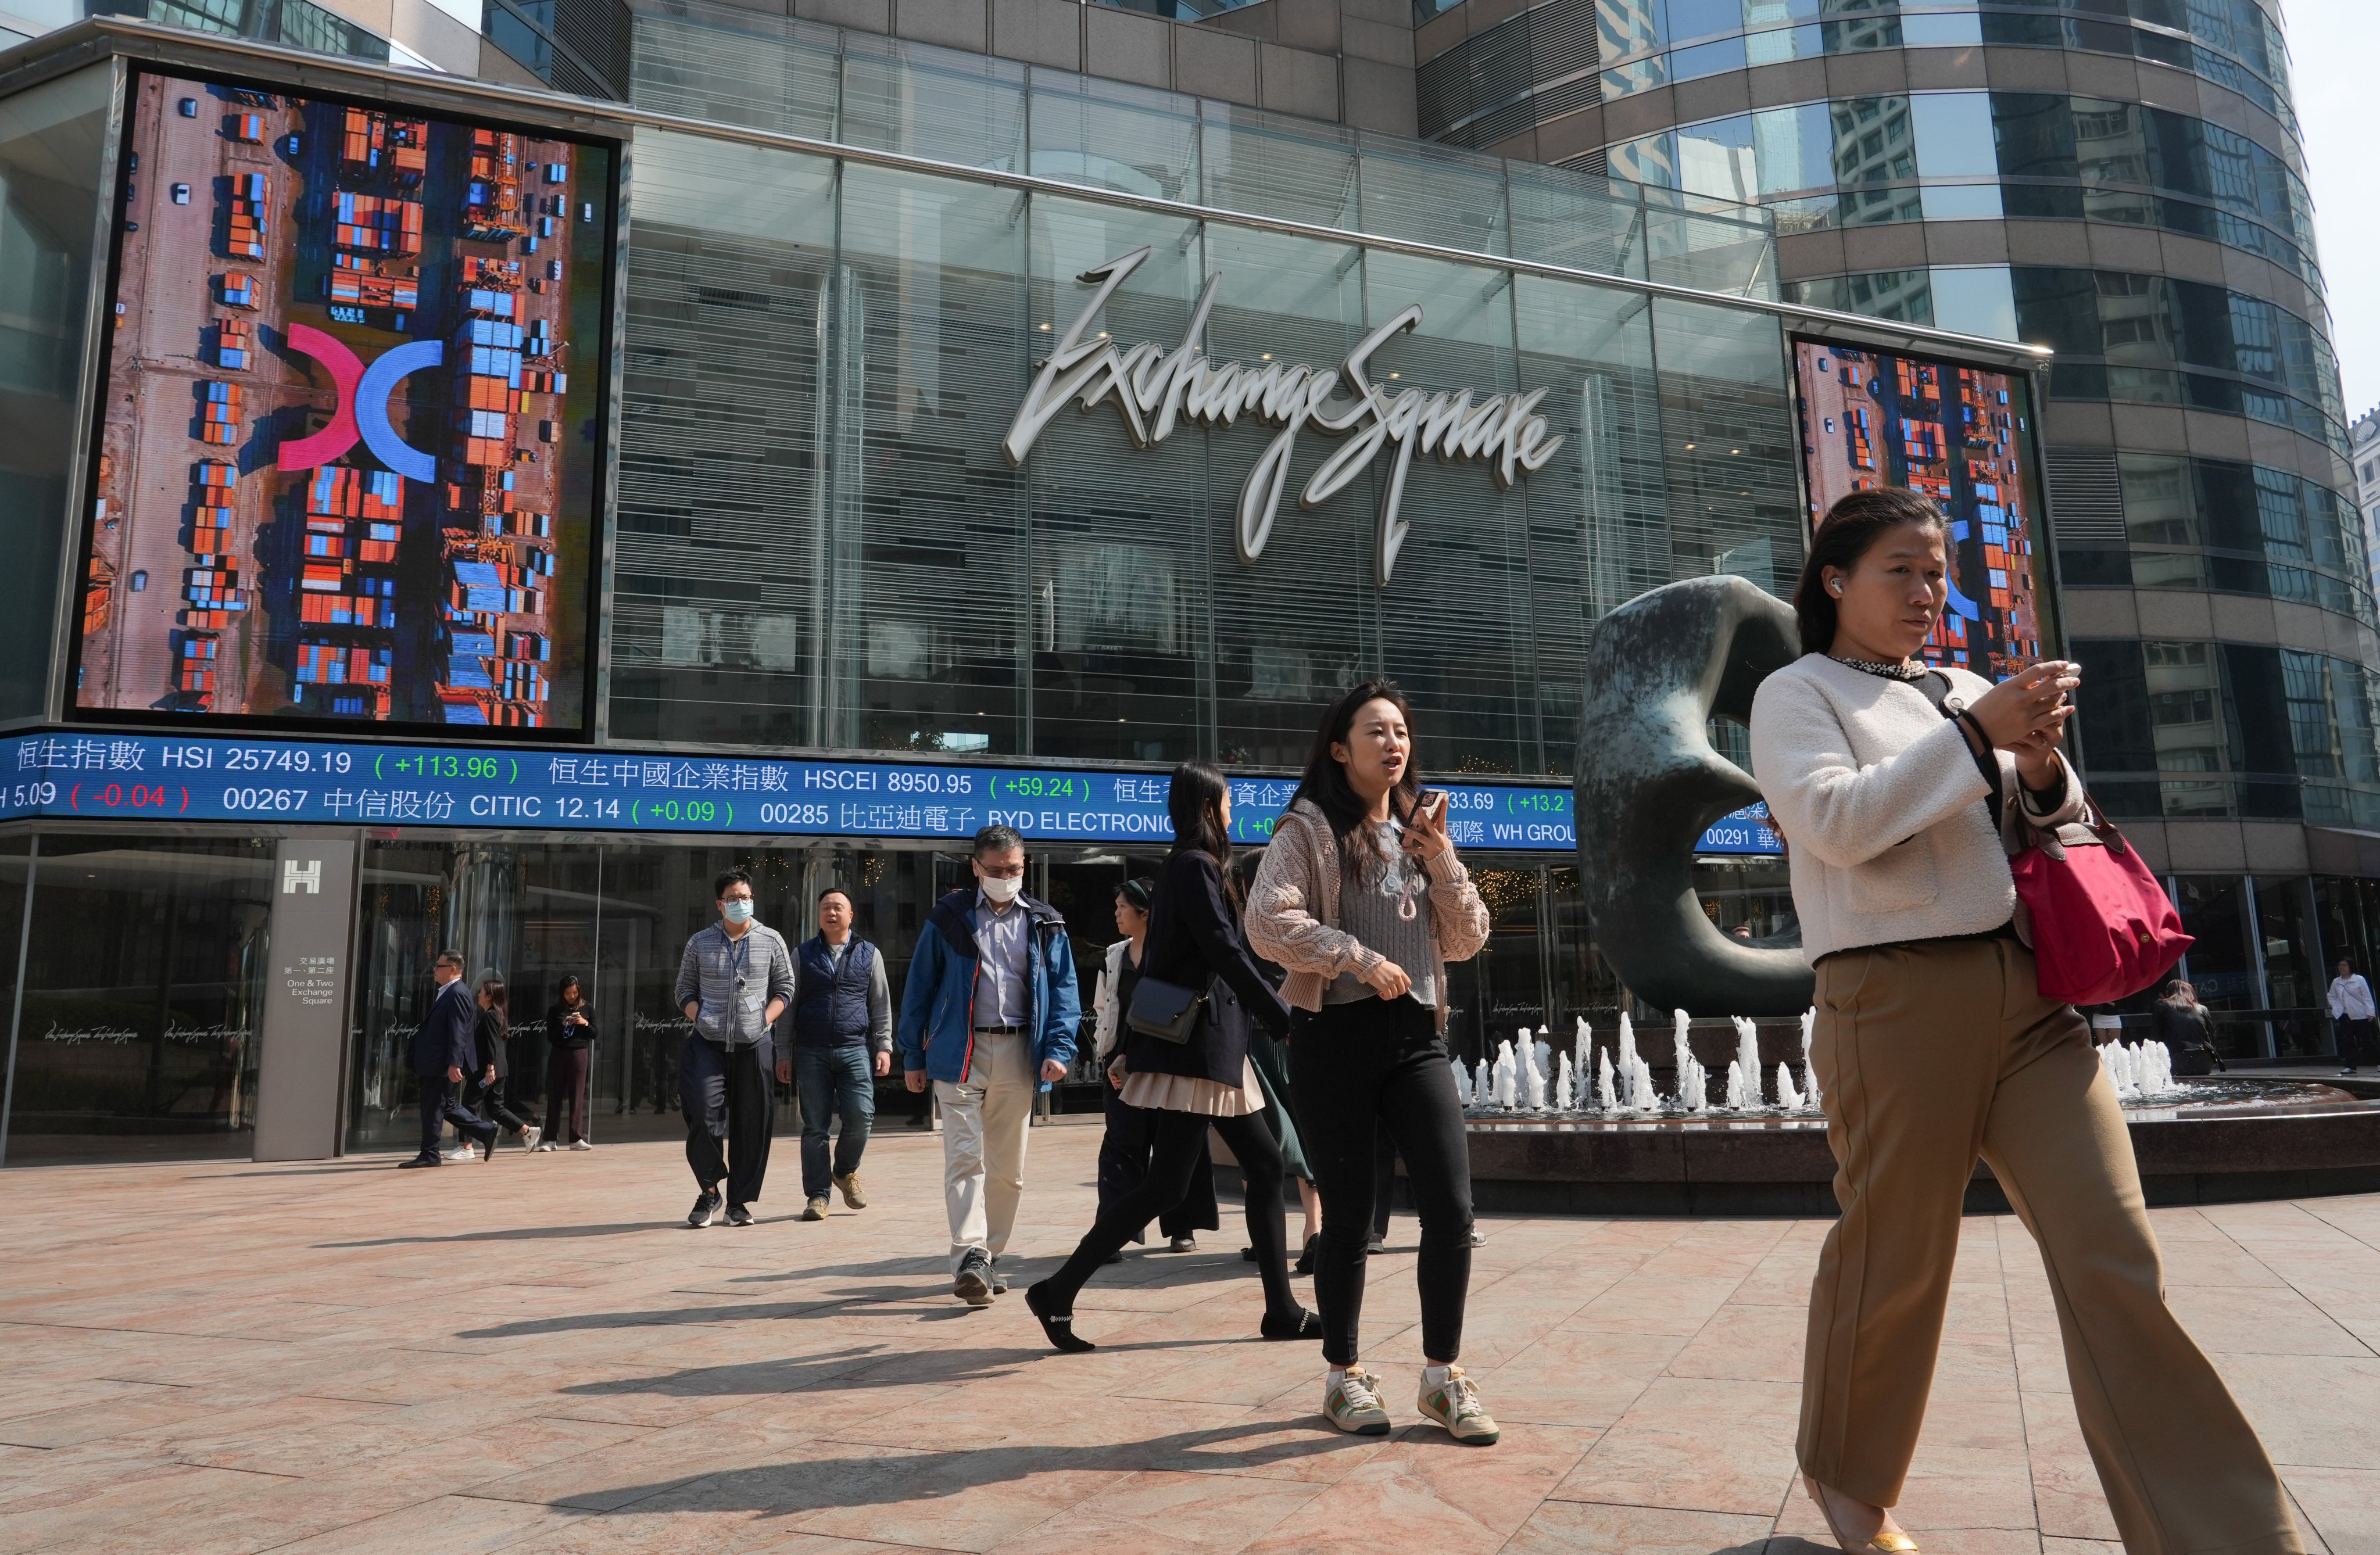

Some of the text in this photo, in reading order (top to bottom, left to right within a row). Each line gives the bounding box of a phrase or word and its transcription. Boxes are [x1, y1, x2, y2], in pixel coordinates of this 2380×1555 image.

[1001, 245, 1566, 588] Exchange Square
[18, 740, 146, 771] 恒生指數
[163, 747, 212, 768] HSI
[226, 749, 351, 773] 25749.19
[549, 757, 789, 791] 恒生中國企業指數
[806, 771, 876, 790] HSCEI
[889, 773, 972, 794] 8950.95
[15, 783, 56, 807] 5.09
[1114, 779, 1169, 803] 恒生
[1225, 782, 1301, 808] 資企業
[1449, 793, 1494, 810] 33.69
[224, 789, 308, 811] 00267
[325, 789, 456, 819] 中信股份
[471, 796, 541, 817] CITIC
[557, 798, 620, 819] 12.14
[762, 804, 829, 825] 00285
[842, 804, 975, 832] 比亞迪電子
[990, 811, 1034, 826] BYD
[1446, 820, 1484, 843] 國際
[1493, 825, 1523, 840] WH
[1708, 827, 1781, 849] 00291 華
[292, 988, 333, 997] Exchange
[302, 997, 332, 1005] Square
